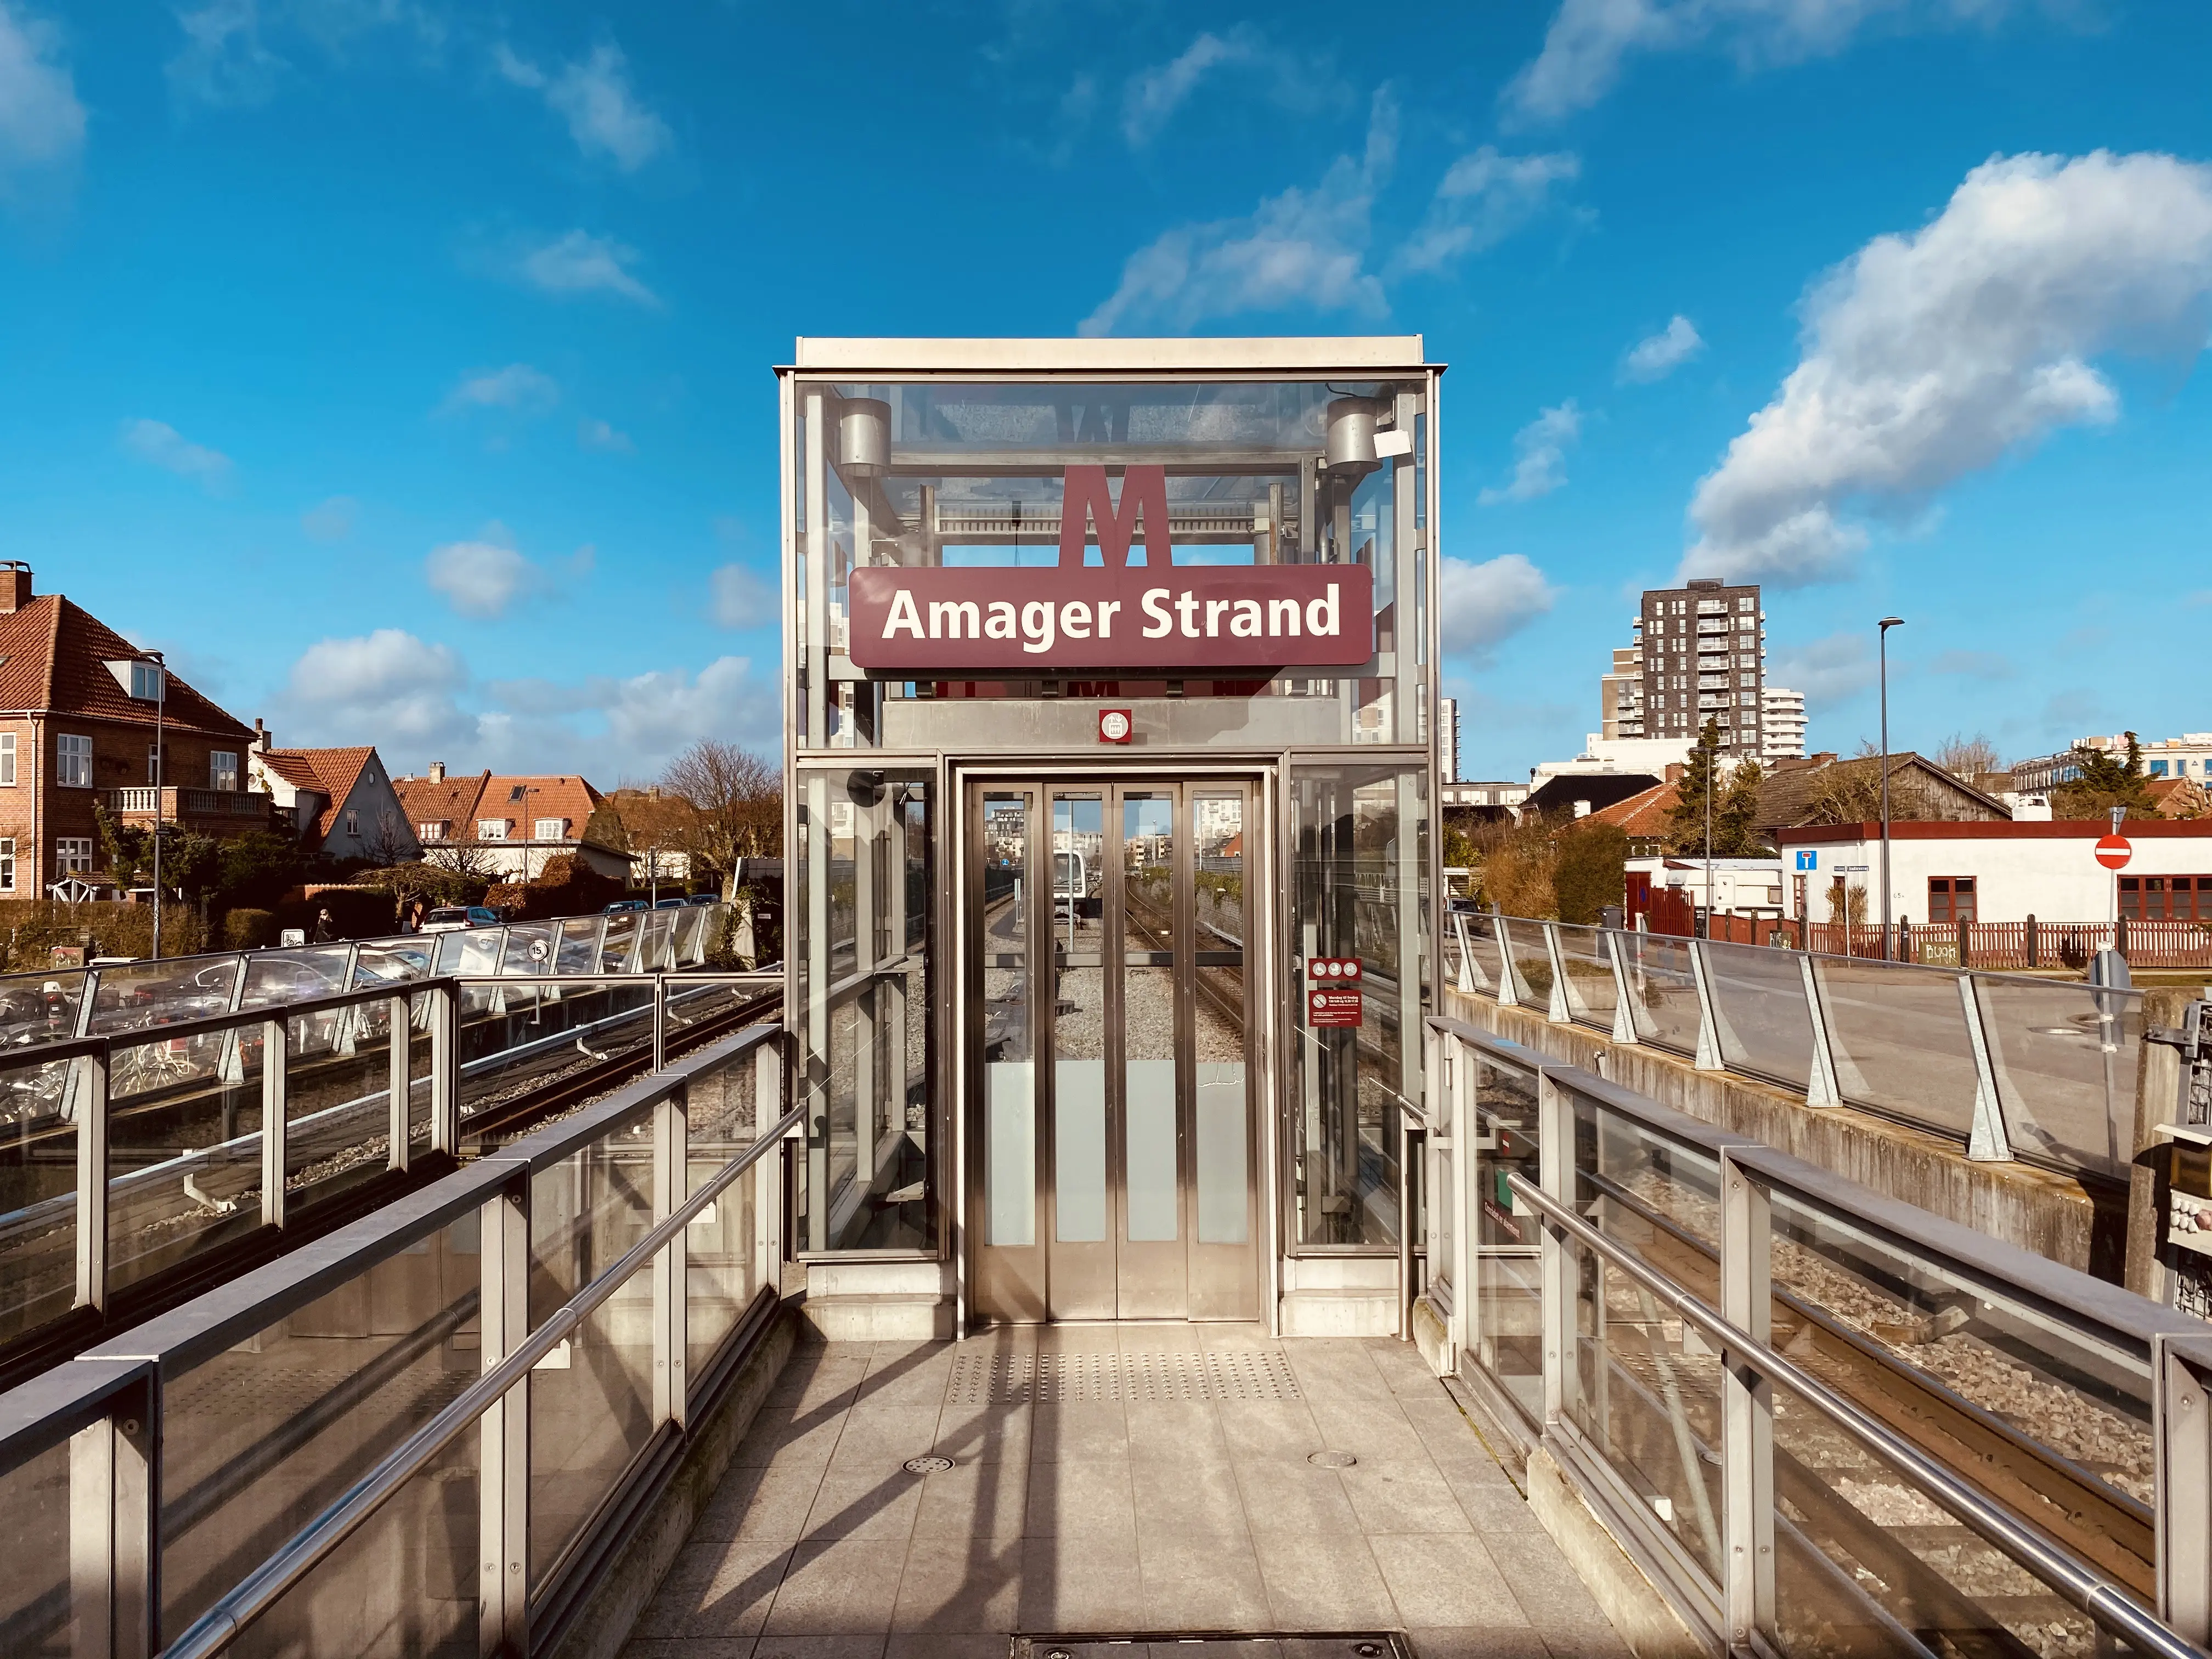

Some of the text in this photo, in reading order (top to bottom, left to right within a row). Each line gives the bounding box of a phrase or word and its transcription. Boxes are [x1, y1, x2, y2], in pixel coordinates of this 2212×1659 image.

[1059, 465, 1172, 568] M
[882, 583, 1341, 653] Amager Strand
